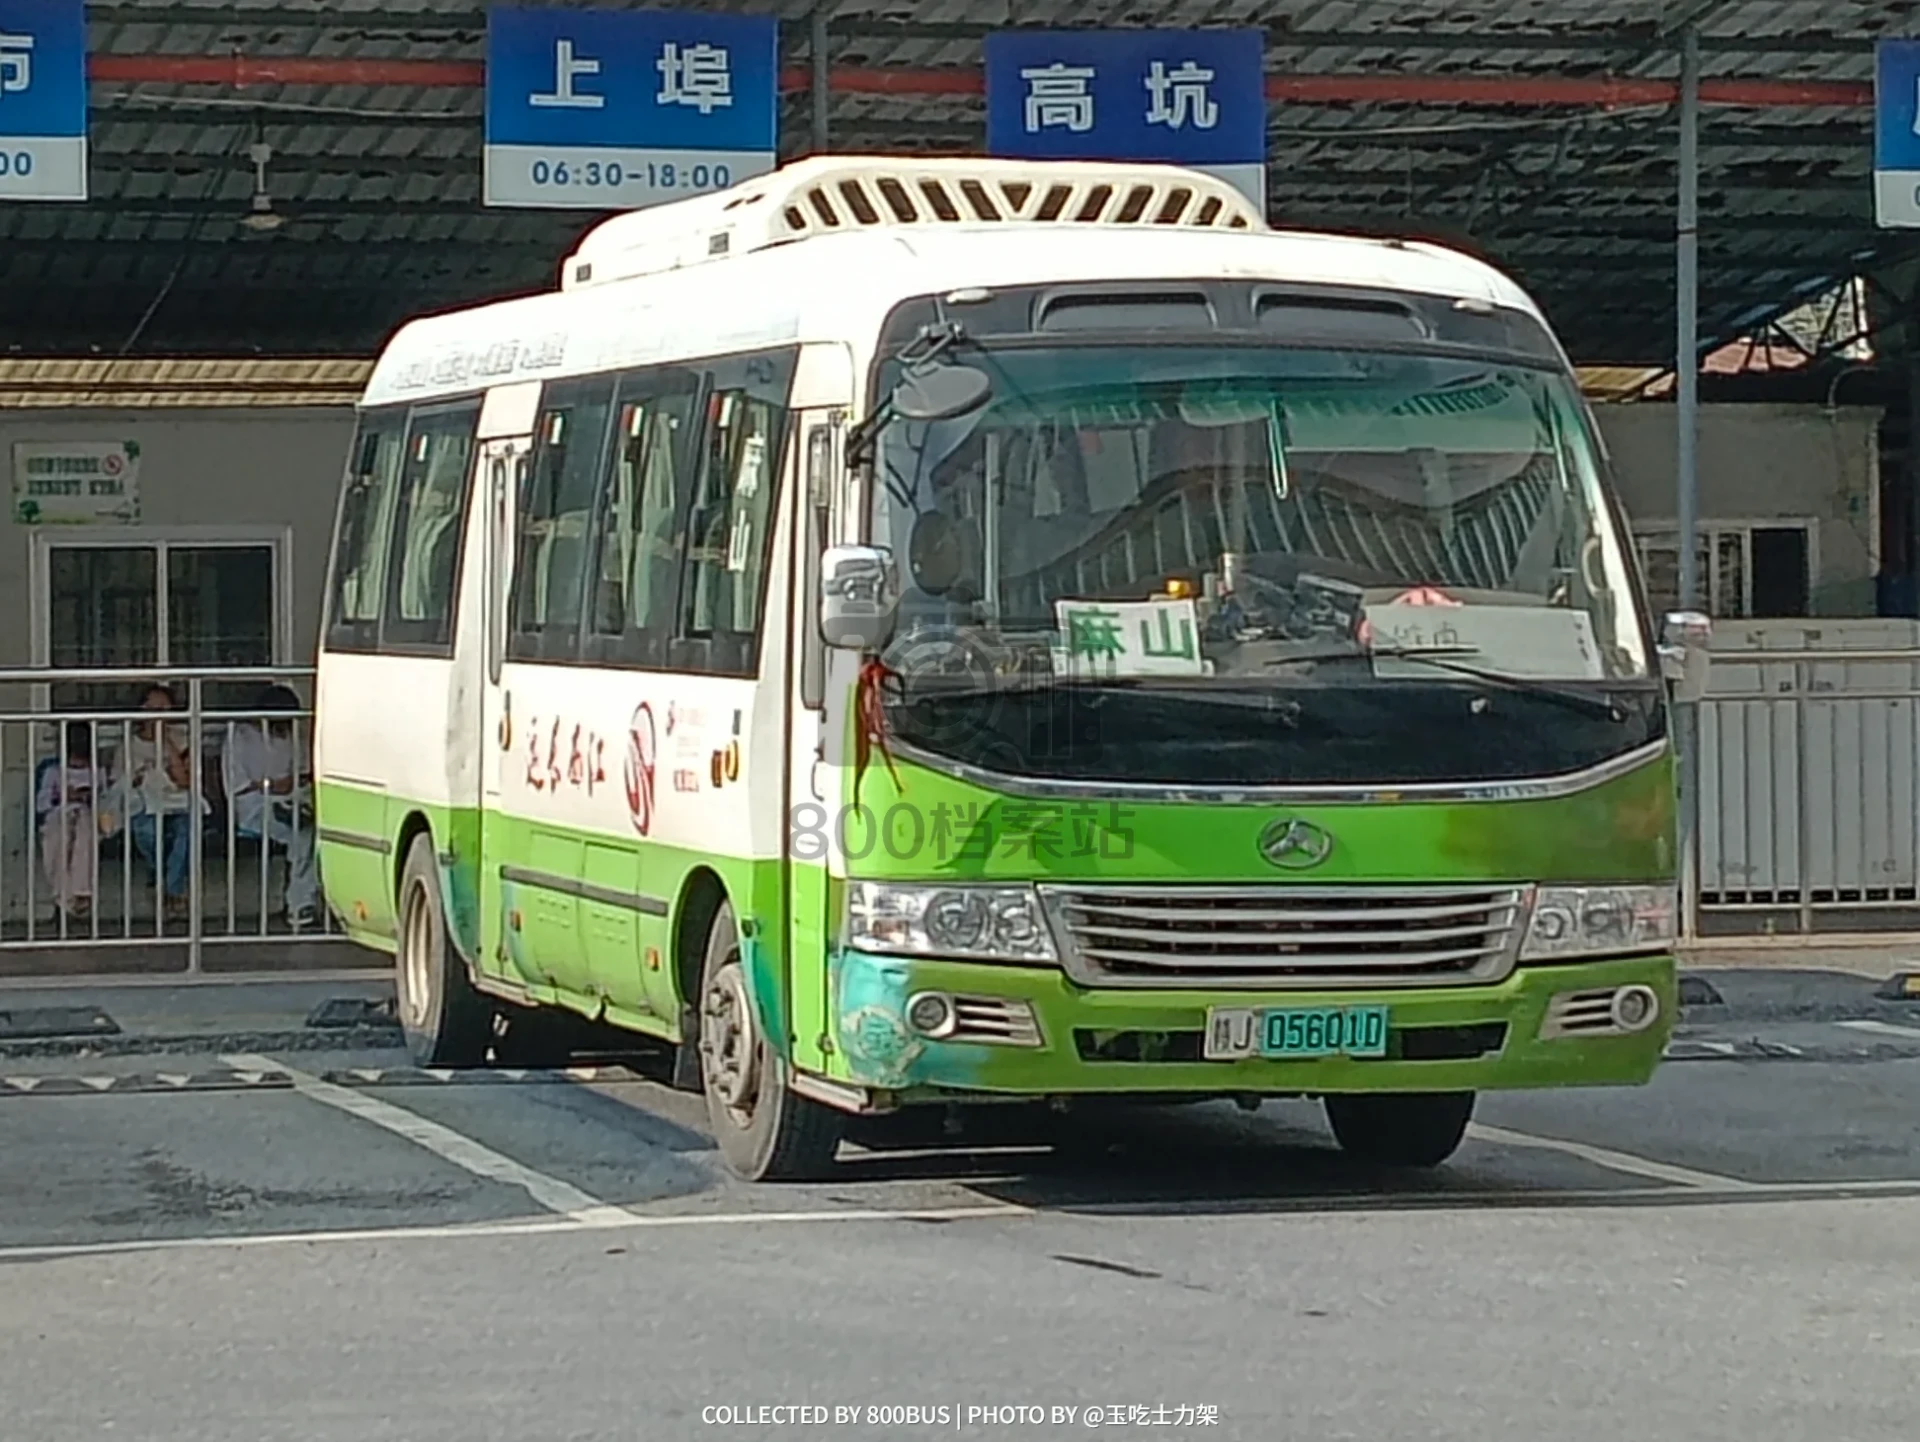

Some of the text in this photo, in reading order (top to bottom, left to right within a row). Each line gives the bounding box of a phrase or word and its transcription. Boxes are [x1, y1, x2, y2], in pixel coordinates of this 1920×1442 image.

[529, 39, 733, 114] 上埠
[1021, 62, 1219, 132] 高坑
[532, 160, 731, 189] 06:30-18:00
